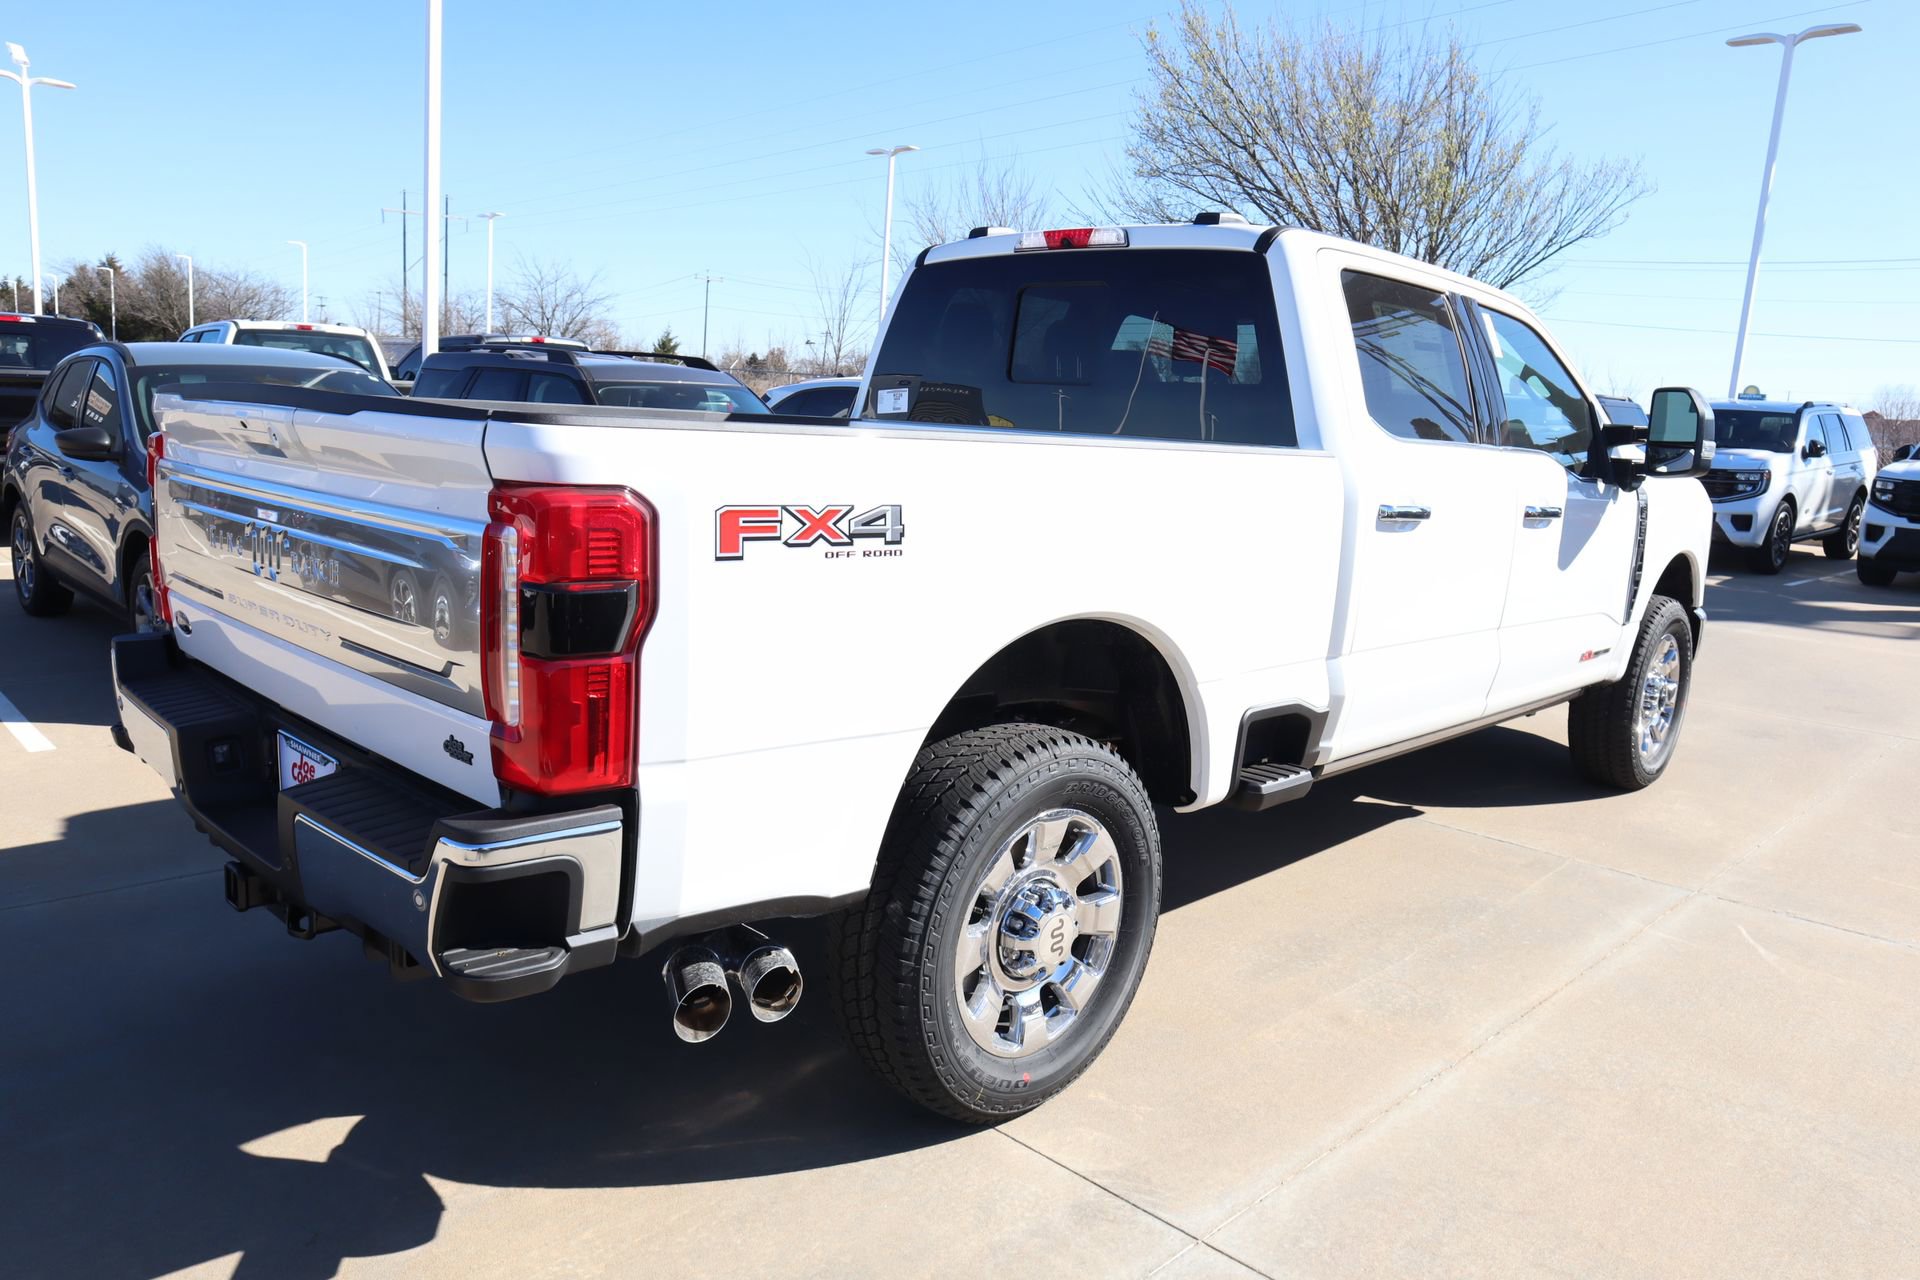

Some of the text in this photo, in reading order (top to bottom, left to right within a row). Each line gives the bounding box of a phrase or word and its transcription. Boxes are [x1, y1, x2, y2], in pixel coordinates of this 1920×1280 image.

[714, 504, 904, 561] FX4
[290, 550, 339, 585] RANCH
[825, 550, 903, 559] OFF ROAD
[228, 593, 332, 640] SUPER DUTY
[290, 740, 320, 761] SHAWNEE
[298, 753, 315, 778] Joe
[1062, 781, 1150, 866] BRIDGESTONE
